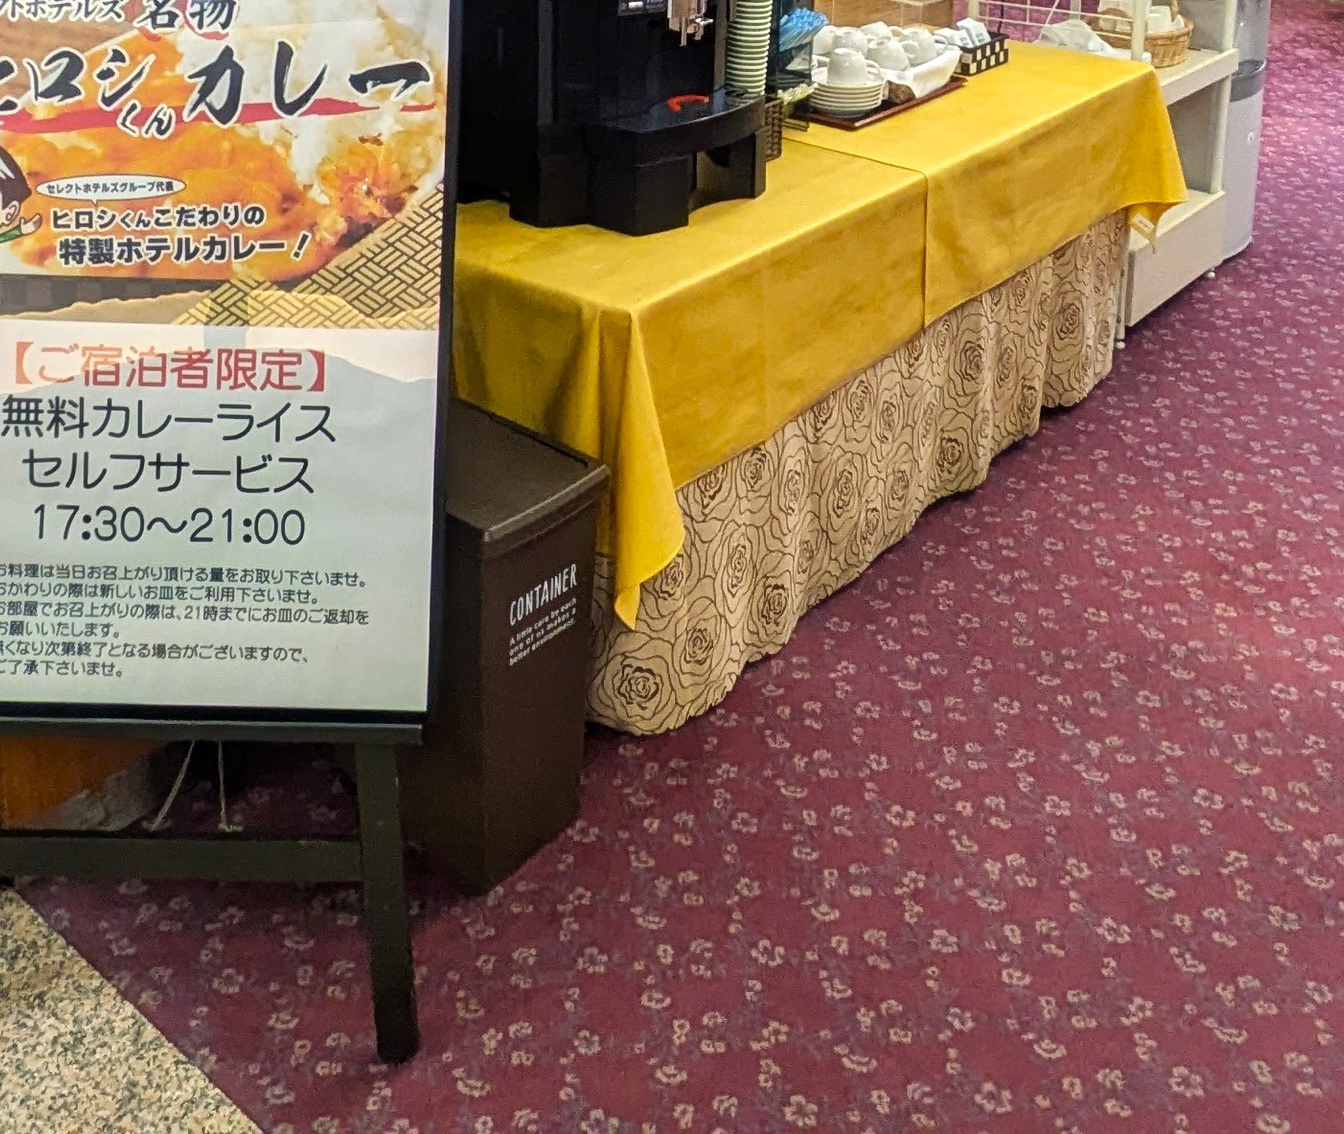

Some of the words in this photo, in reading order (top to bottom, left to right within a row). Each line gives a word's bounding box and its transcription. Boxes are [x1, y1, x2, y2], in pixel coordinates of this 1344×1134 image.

[120, 103, 172, 136] くん
[186, 41, 433, 123] カレー
[47, 180, 174, 194] セレクトホテルズグループ代表
[53, 206, 265, 229] ヒロシくんこだわりの
[15, 342, 325, 392] 【ご宿泊者限定】
[1, 395, 336, 442] 無料カレーライス
[22, 449, 314, 494] セルフサービス
[509, 564, 577, 626] CONTAINER
